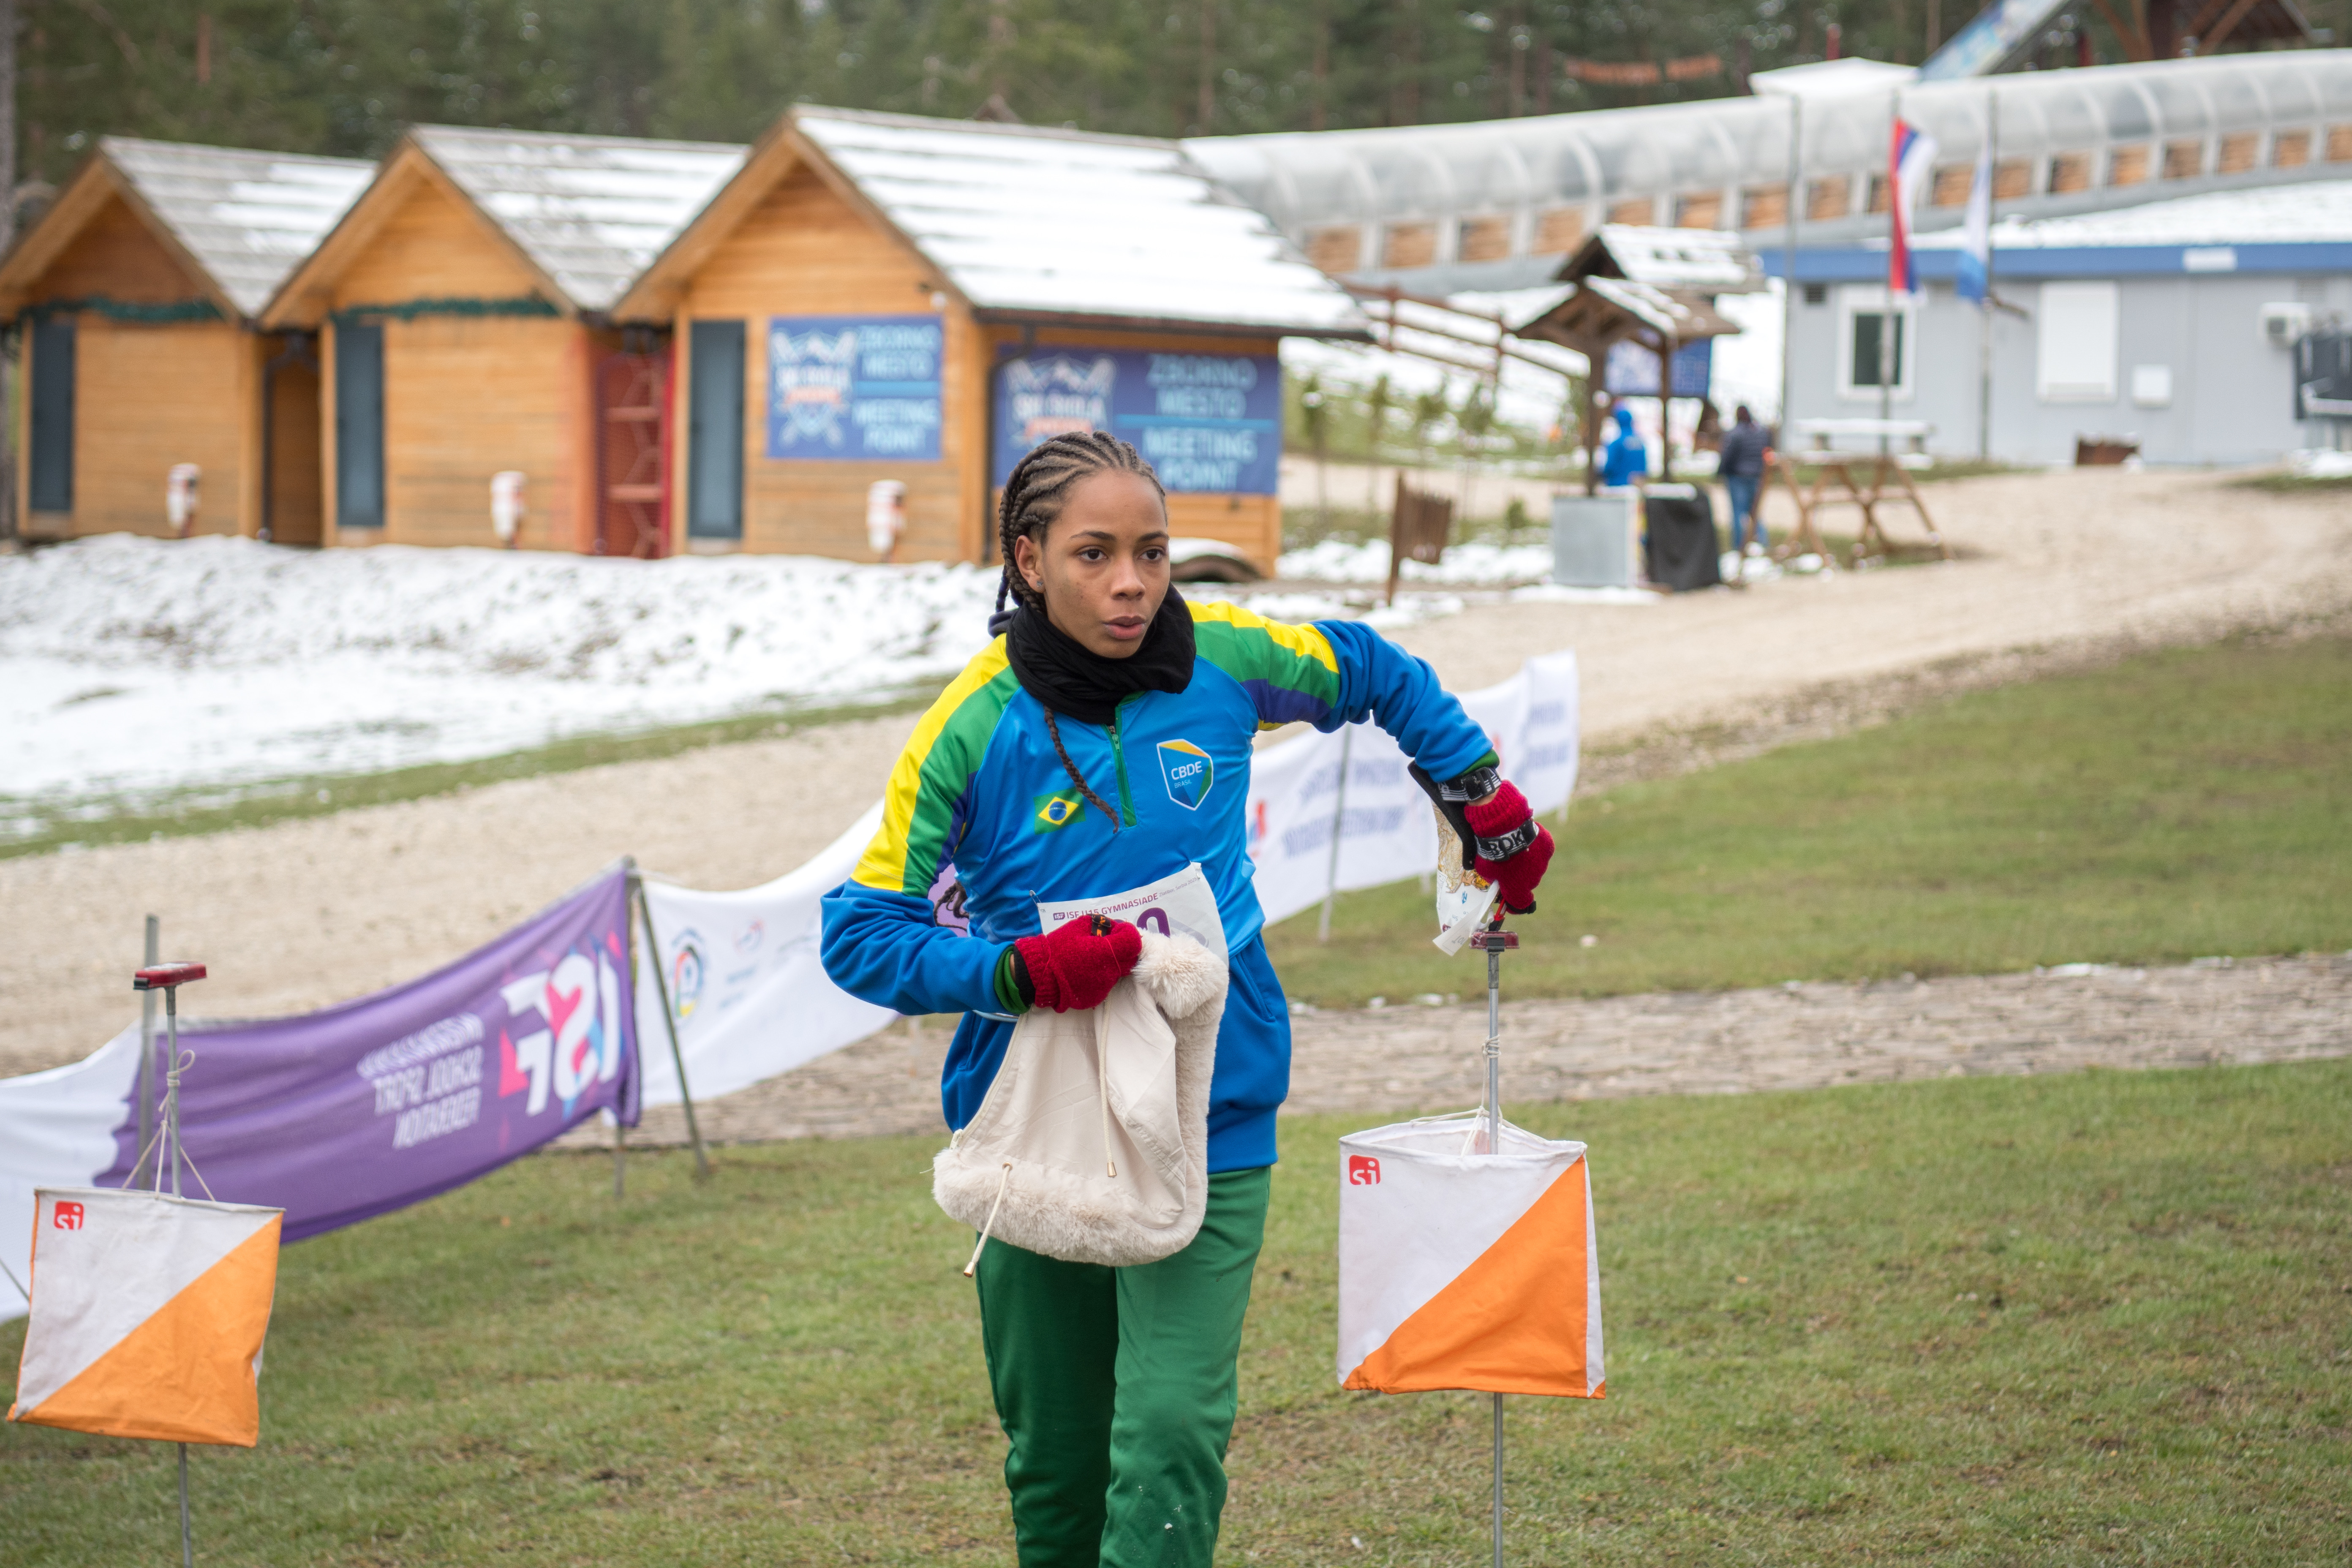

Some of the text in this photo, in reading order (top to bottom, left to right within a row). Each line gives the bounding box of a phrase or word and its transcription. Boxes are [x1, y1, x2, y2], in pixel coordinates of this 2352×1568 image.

[1171, 760, 1203, 780] CBDE
[1174, 779, 1192, 788] BRASIL
[1159, 888, 1176, 897] Zlatibor,
[1175, 882, 1187, 890] Serbia
[1067, 911, 1079, 919] ISF
[1101, 892, 1159, 915] GYMNASIADE
